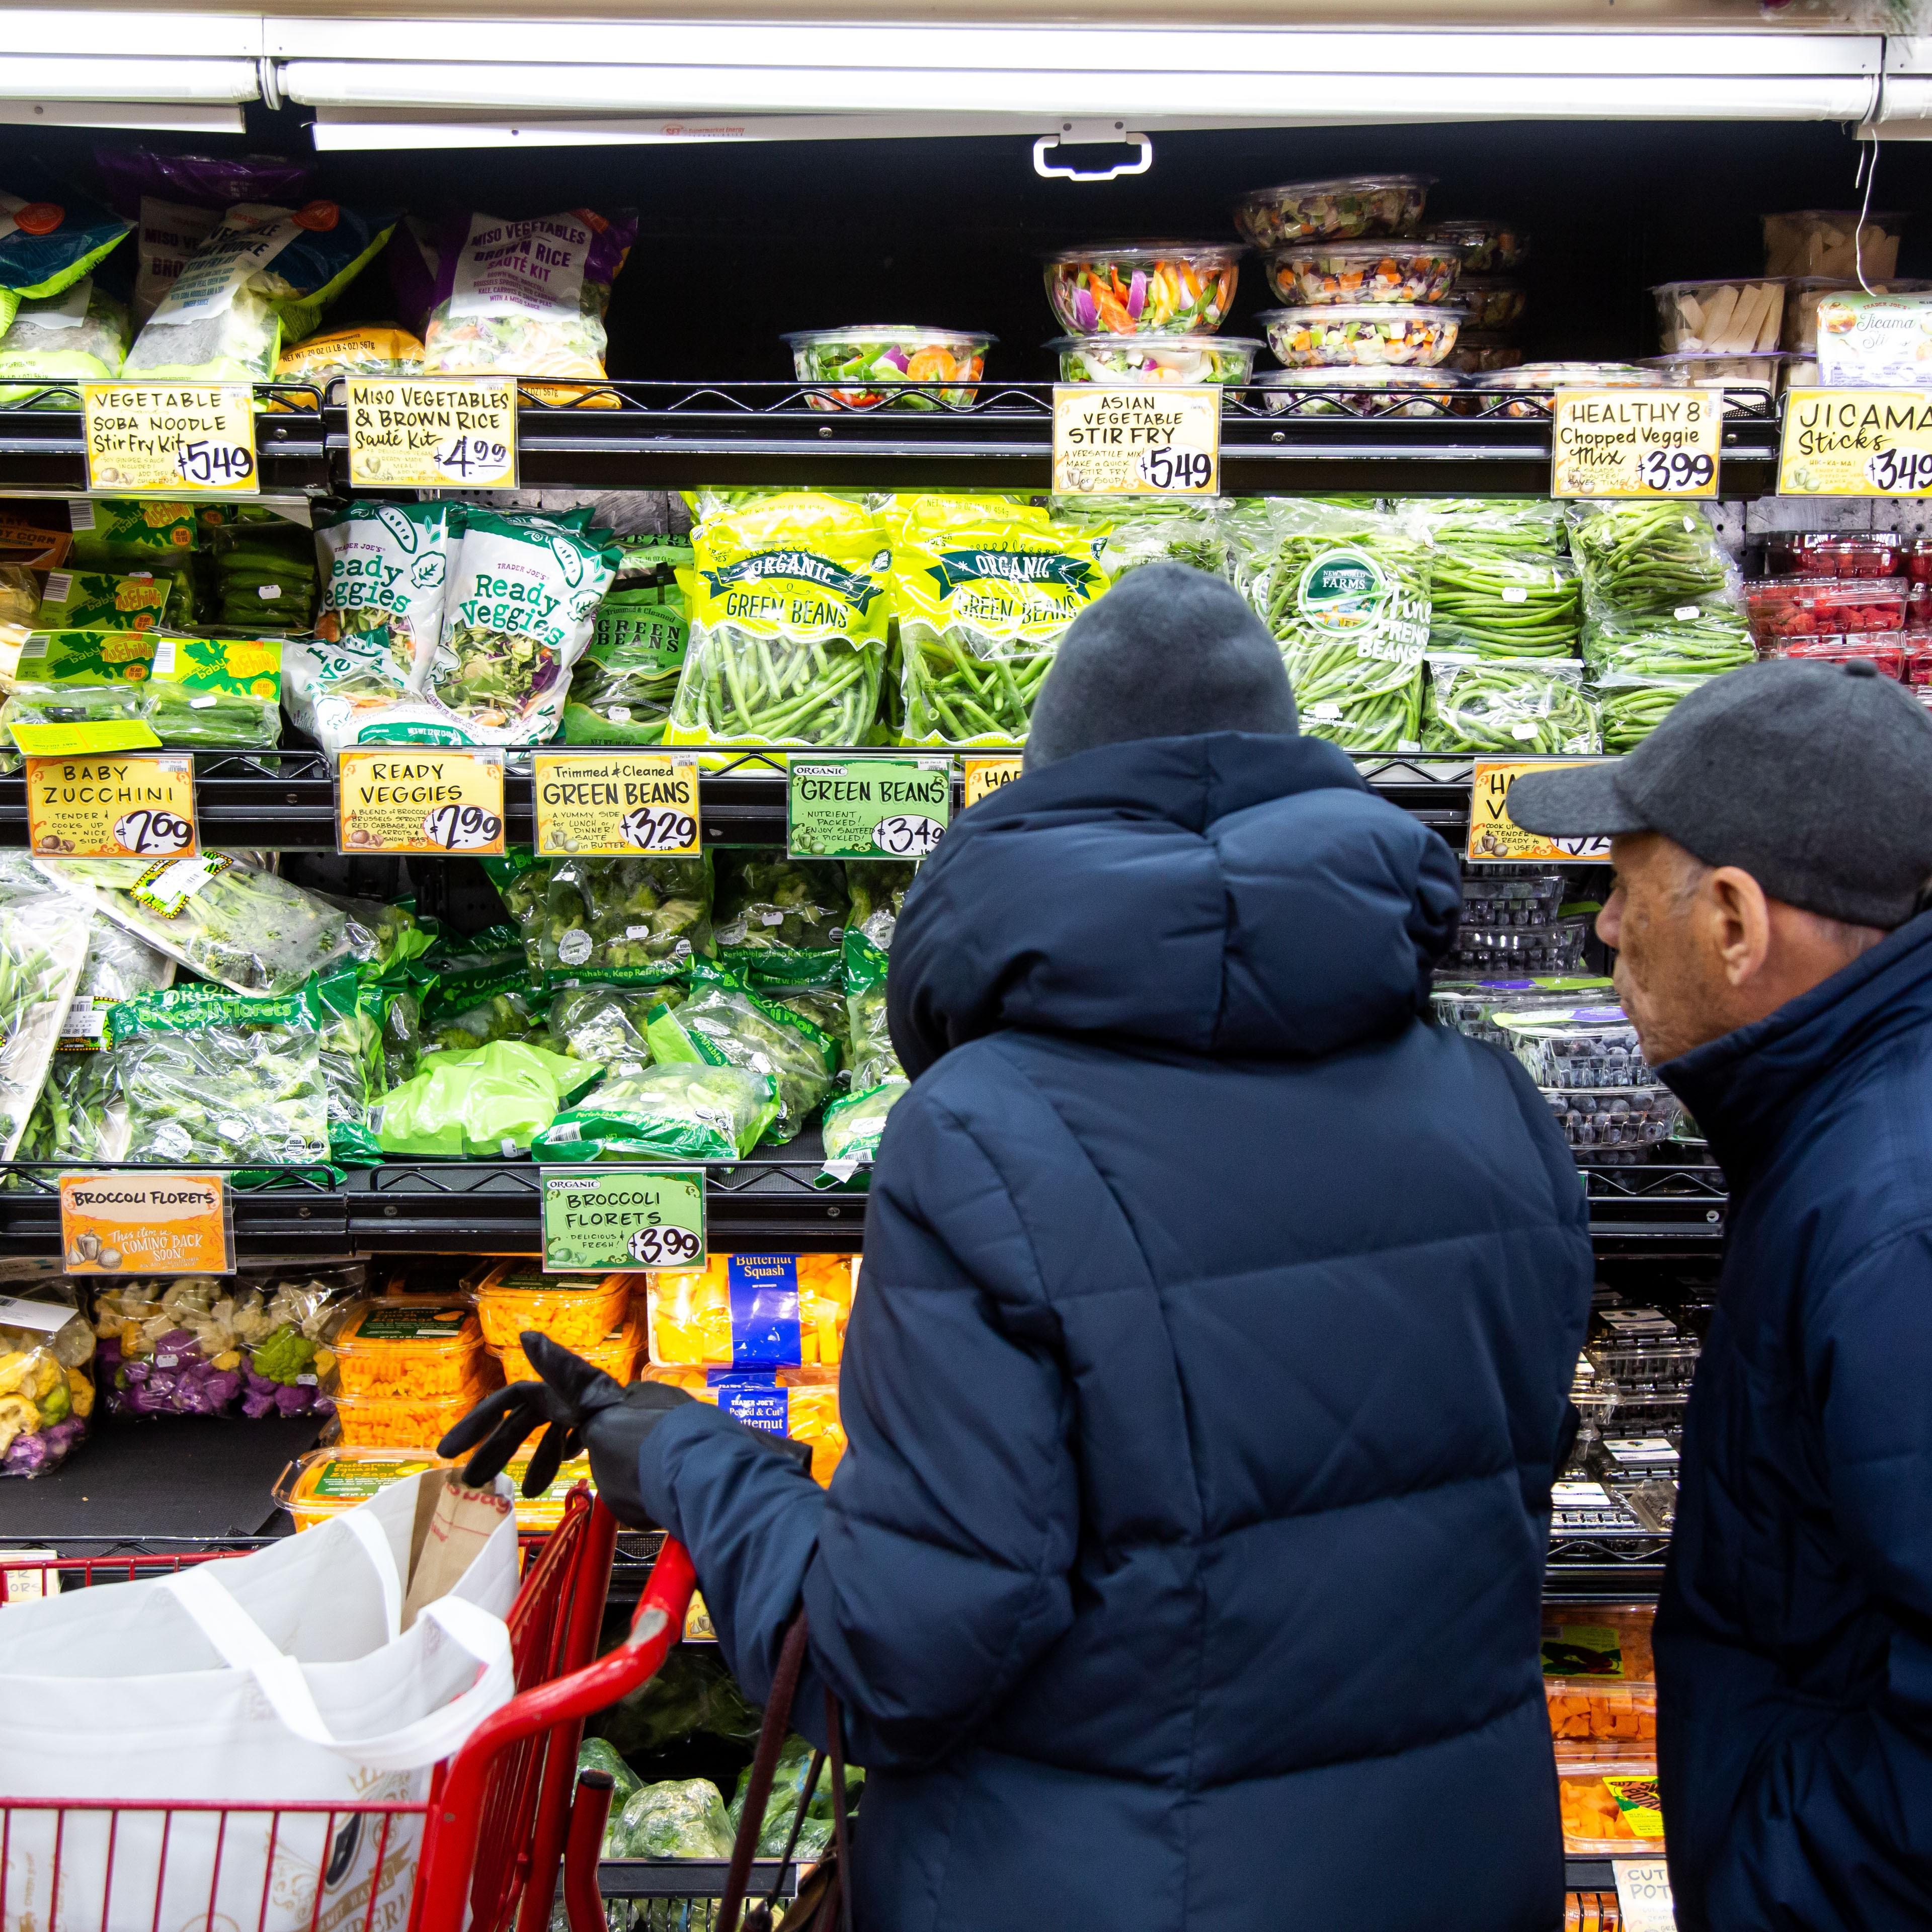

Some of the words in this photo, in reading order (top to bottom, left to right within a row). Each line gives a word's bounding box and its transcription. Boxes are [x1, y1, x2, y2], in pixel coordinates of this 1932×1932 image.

[471, 228, 502, 246] MISO
[505, 221, 586, 245] VEGETABLES
[535, 243, 572, 267] RICE
[530, 263, 551, 282] KIT
[1863, 302, 1887, 310] TRADER
[1888, 302, 1908, 310] JOE'S
[1857, 313, 1916, 332] Jicama
[282, 355, 295, 363] NET
[359, 340, 375, 350] 567g
[96, 392, 221, 408] VEGETABLE
[401, 387, 509, 410] VEGETABLES
[543, 387, 558, 397] 567g
[1101, 396, 1155, 410] ASIAN
[1572, 402, 1680, 423] HEALTHY
[1686, 401, 1701, 423] 8
[94, 416, 139, 432] SOBA
[150, 416, 226, 431] NOODLE
[355, 408, 373, 428] &
[378, 409, 450, 427] BROWN
[456, 411, 500, 430] RICE
[1083, 412, 1183, 426] VEGETABLE
[1800, 403, 1932, 432] JICAMA
[94, 434, 126, 452] Stir
[129, 434, 154, 455] Fry
[158, 433, 186, 452] Kit
[355, 429, 404, 449] Sauté
[408, 429, 443, 450] Kit
[1069, 428, 1123, 444] STIR
[1131, 427, 1175, 444] FRY
[1560, 427, 1636, 449] Chopped
[1641, 426, 1700, 449] Veggie
[1798, 427, 1892, 456] Sticks
[1072, 449, 1123, 458] VERSATILE
[1066, 460, 1092, 468] MAKE
[1103, 460, 1131, 468] QUICK
[1080, 468, 1103, 476] STIR
[1110, 468, 1129, 476] FRY
[1094, 476, 1126, 484] SOUP!
[1568, 478, 1595, 487] SAVES
[993, 506, 1009, 518] 454g
[117, 510, 143, 533] baby
[334, 542, 359, 553] TRADER
[360, 543, 383, 552] JOE'S
[330, 555, 404, 588] eady
[497, 562, 525, 573] TRADER
[526, 568, 547, 581] JOE'S
[750, 552, 835, 583] ORGANIC
[975, 554, 1056, 582] ORGANIC
[1323, 569, 1339, 577] NEW
[1339, 570, 1366, 579] WORLD
[1322, 578, 1366, 590] FARMS
[87, 592, 116, 611] baby
[319, 582, 413, 613] eggies
[474, 574, 561, 618] Ready
[605, 606, 636, 616] Trimmed
[643, 607, 676, 623] Cleaned
[727, 593, 785, 621] GREEN
[791, 599, 849, 629] BEANS
[958, 593, 1014, 622] GREEN
[1021, 594, 1078, 625] BEANS
[459, 600, 566, 647] Veggies
[596, 619, 682, 640] GREEN
[1378, 618, 1430, 647] FRENC
[595, 632, 680, 653] BEANS
[1356, 637, 1426, 666] BEANS
[69, 646, 101, 664] baby
[196, 658, 227, 680] baby
[63, 765, 129, 781] BABY
[372, 763, 444, 780] READY
[553, 766, 609, 778] Trimmed
[622, 765, 674, 777] Cleaned
[796, 766, 846, 776] ORGANIC
[43, 786, 173, 804] ZUCCHINI
[360, 784, 463, 804] VEGGIES
[543, 783, 619, 806] GREEN
[623, 781, 690, 805] BEANS
[800, 779, 871, 802] GREEN
[880, 781, 945, 804] BEANS
[574, 823, 615, 834] DINNER!
[837, 826, 875, 835] SAUTEED
[79, 836, 110, 845] SIDE!
[591, 840, 630, 849] BUTTER!
[822, 834, 865, 842] PICKLED!
[612, 970, 633, 979] Keep
[138, 1001, 219, 1023] Broccoli
[222, 1001, 292, 1019] Florets
[550, 1181, 599, 1189] ORGANIC
[72, 1191, 146, 1206] BROCCOLI
[149, 1191, 216, 1204] FLORETS
[566, 1191, 661, 1209] BROCCOLI
[565, 1211, 662, 1229] FLORETS
[108, 1229, 134, 1244] This
[121, 1236, 168, 1254] COMING
[172, 1233, 204, 1248] BACK
[582, 1240, 620, 1249] FRESH!
[153, 1248, 186, 1261] SOON!
[736, 1256, 792, 1266] Butternut
[743, 1265, 785, 1277] Squash
[756, 1408, 764, 1416] &
[765, 1407, 781, 1416] Cut
[1627, 1869, 1666, 1881] CUT
